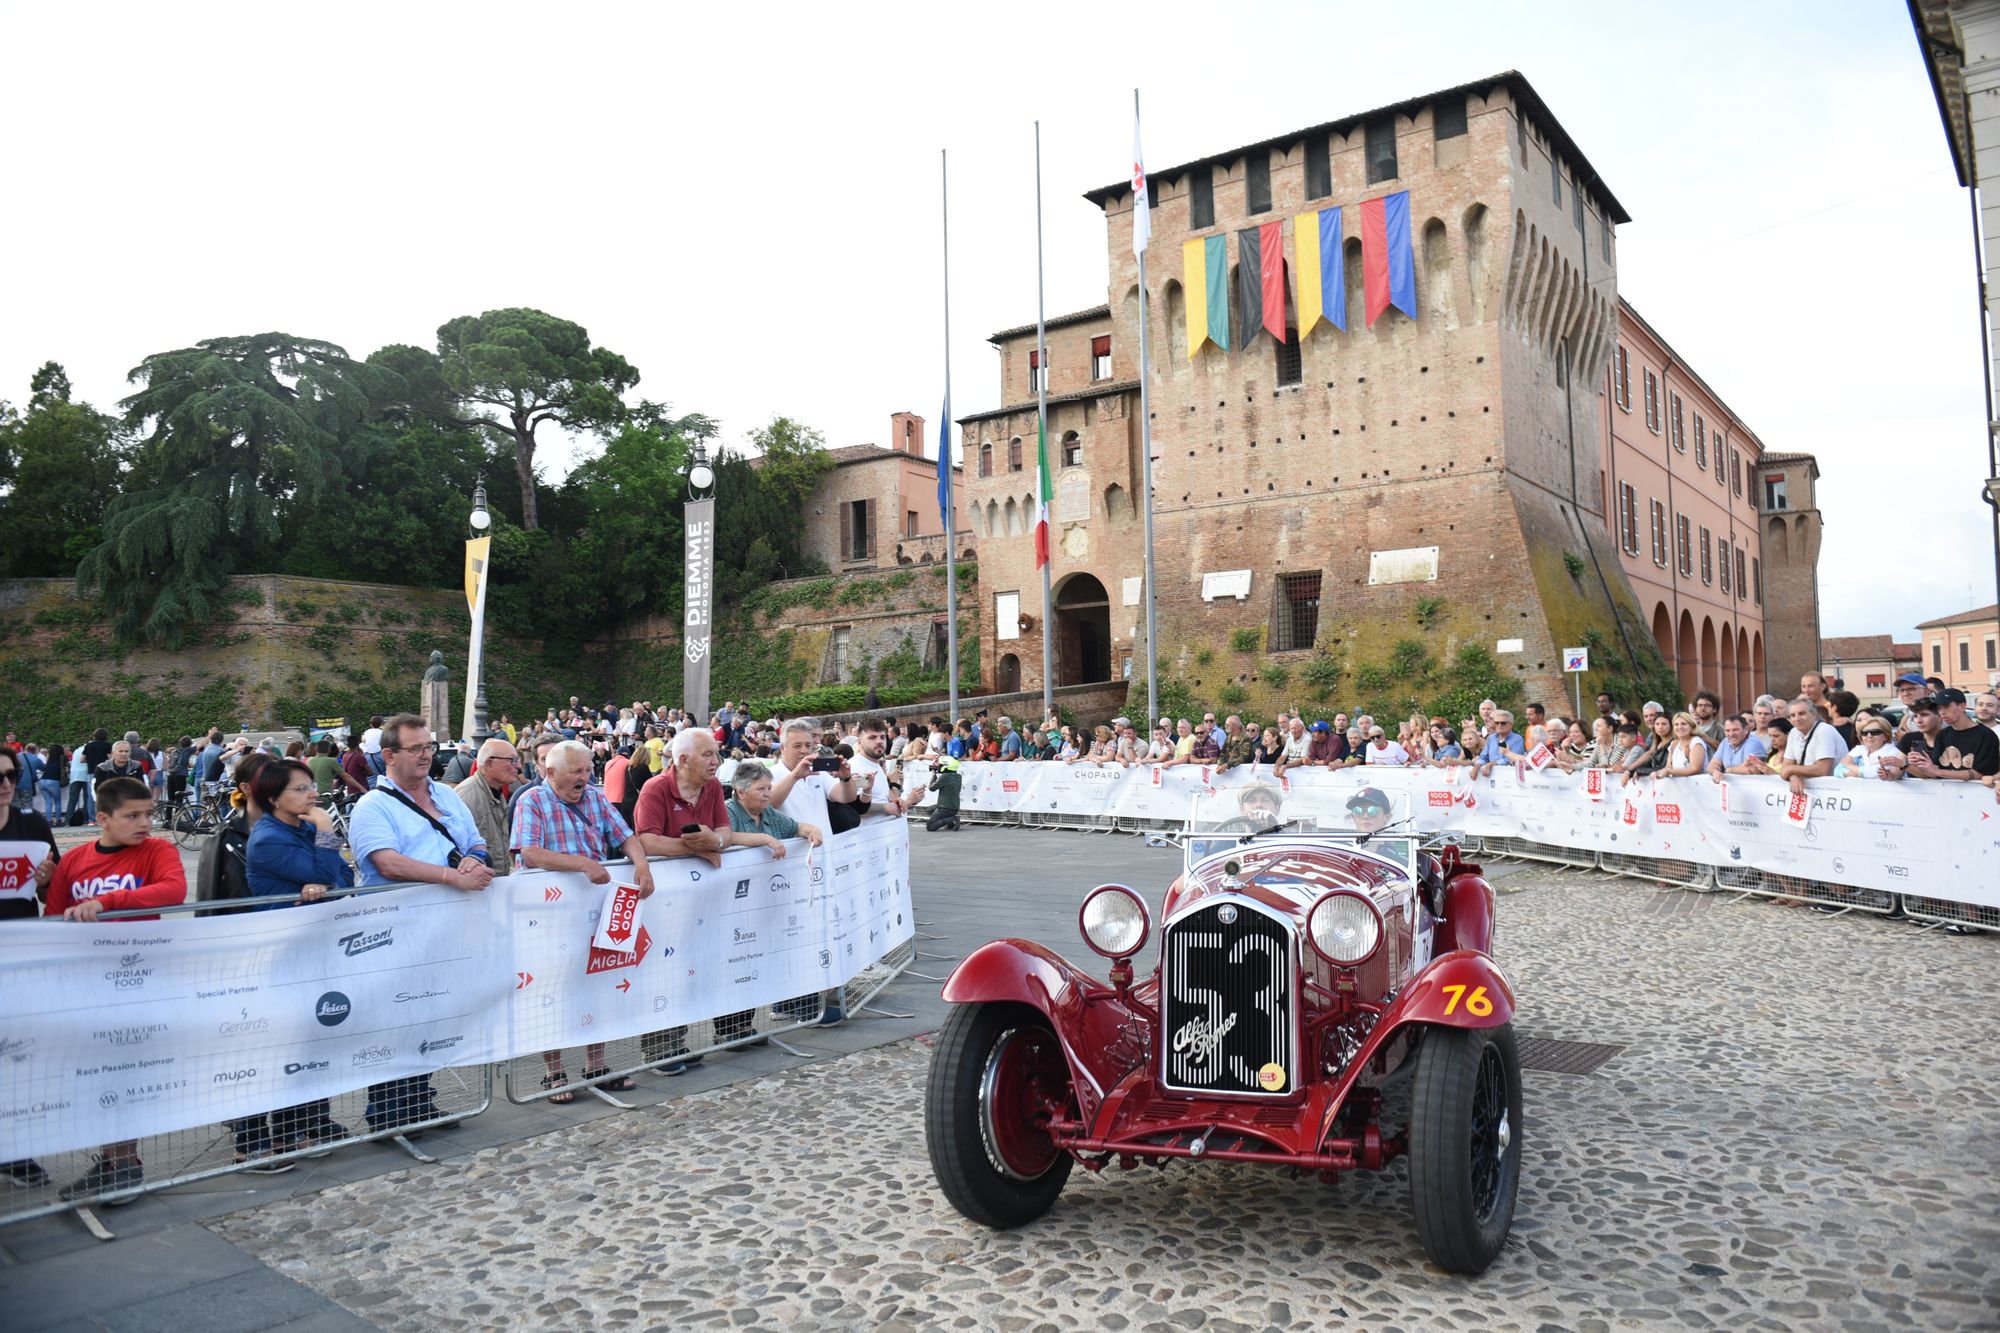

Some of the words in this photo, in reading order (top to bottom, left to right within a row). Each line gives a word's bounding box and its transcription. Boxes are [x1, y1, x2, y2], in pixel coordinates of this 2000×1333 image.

[687, 521, 702, 626] DIEMME
[701, 557, 710, 625] ENOLOGIA
[1075, 771, 1120, 780] CHOPARD
[1765, 793, 1852, 811] CHARD
[71, 874, 137, 900] NASA
[334, 910, 361, 920] Official
[362, 907, 378, 915] Soft
[379, 905, 400, 913] Drink
[609, 889, 628, 932] MIGLIA
[621, 894, 638, 931] 1000
[93, 938, 129, 946] Official
[131, 937, 172, 946] Supplier
[338, 926, 394, 957] Tassoni
[590, 950, 637, 971] MIGLIA
[105, 968, 152, 980] CIPRIANI
[115, 977, 144, 988] FOOD
[735, 975, 752, 984] waze
[197, 989, 226, 999] Special
[228, 986, 259, 995] Partner
[393, 989, 451, 1003] Santoni
[1442, 984, 1494, 1017] 76
[318, 1001, 348, 1016] Leica
[92, 1024, 168, 1039] FRANCIACORTA
[1173, 1016, 1211, 1058] Alfa
[1185, 1012, 1238, 1064] Romeo
[76, 1069, 99, 1077] Race
[101, 1063, 136, 1073] Passion
[138, 1057, 175, 1068] Sponsor
[213, 1068, 257, 1083] mupa
[284, 1061, 329, 1075] Online
[126, 1080, 189, 1097] MARREYT
